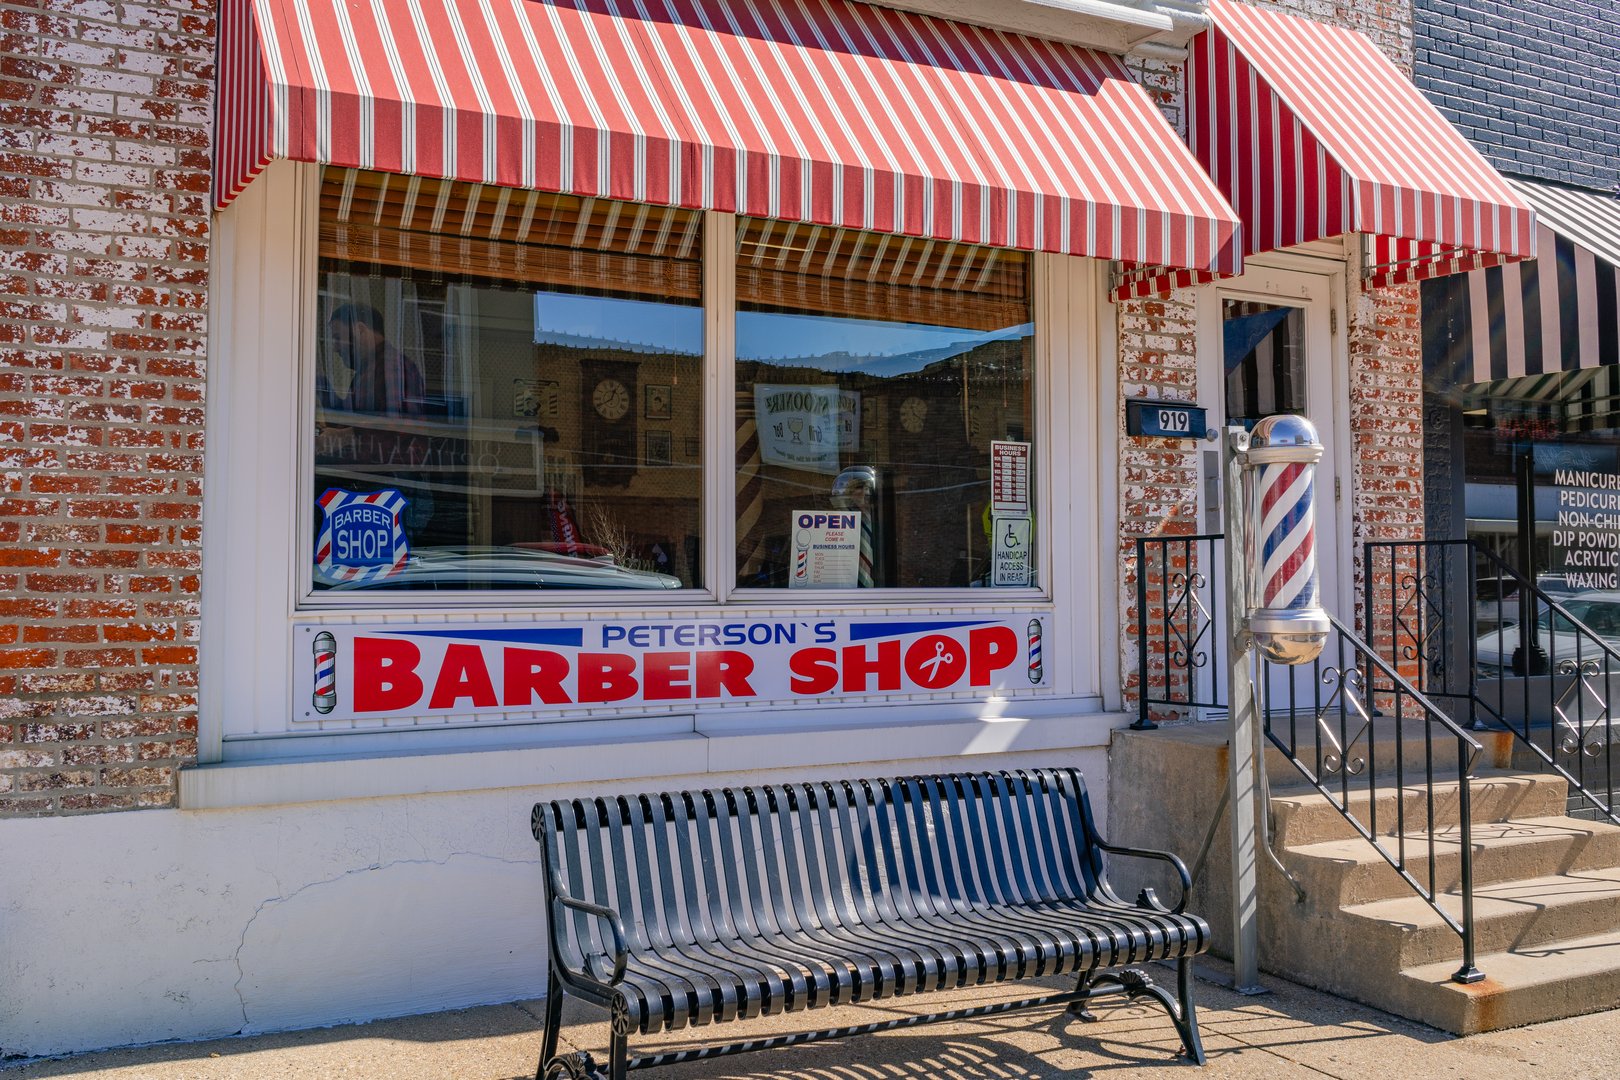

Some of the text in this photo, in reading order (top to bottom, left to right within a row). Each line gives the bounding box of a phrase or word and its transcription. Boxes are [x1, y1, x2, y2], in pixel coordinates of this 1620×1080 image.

[1160, 411, 1188, 430] 919
[994, 444, 1026, 452] BUSINESS
[334, 509, 391, 530] BARBER
[798, 514, 856, 529] OPEN
[337, 529, 388, 559] SHOP
[1553, 530, 1620, 549] DIP POWD
[997, 551, 1027, 559] HANDICAP
[1564, 550, 1619, 567] ACRYLIC
[1000, 562, 1023, 570] ACCESS
[1000, 573, 1023, 581] IN REAR
[1565, 572, 1618, 588] WAXING
[353, 626, 1018, 713] BARBER SHOP
